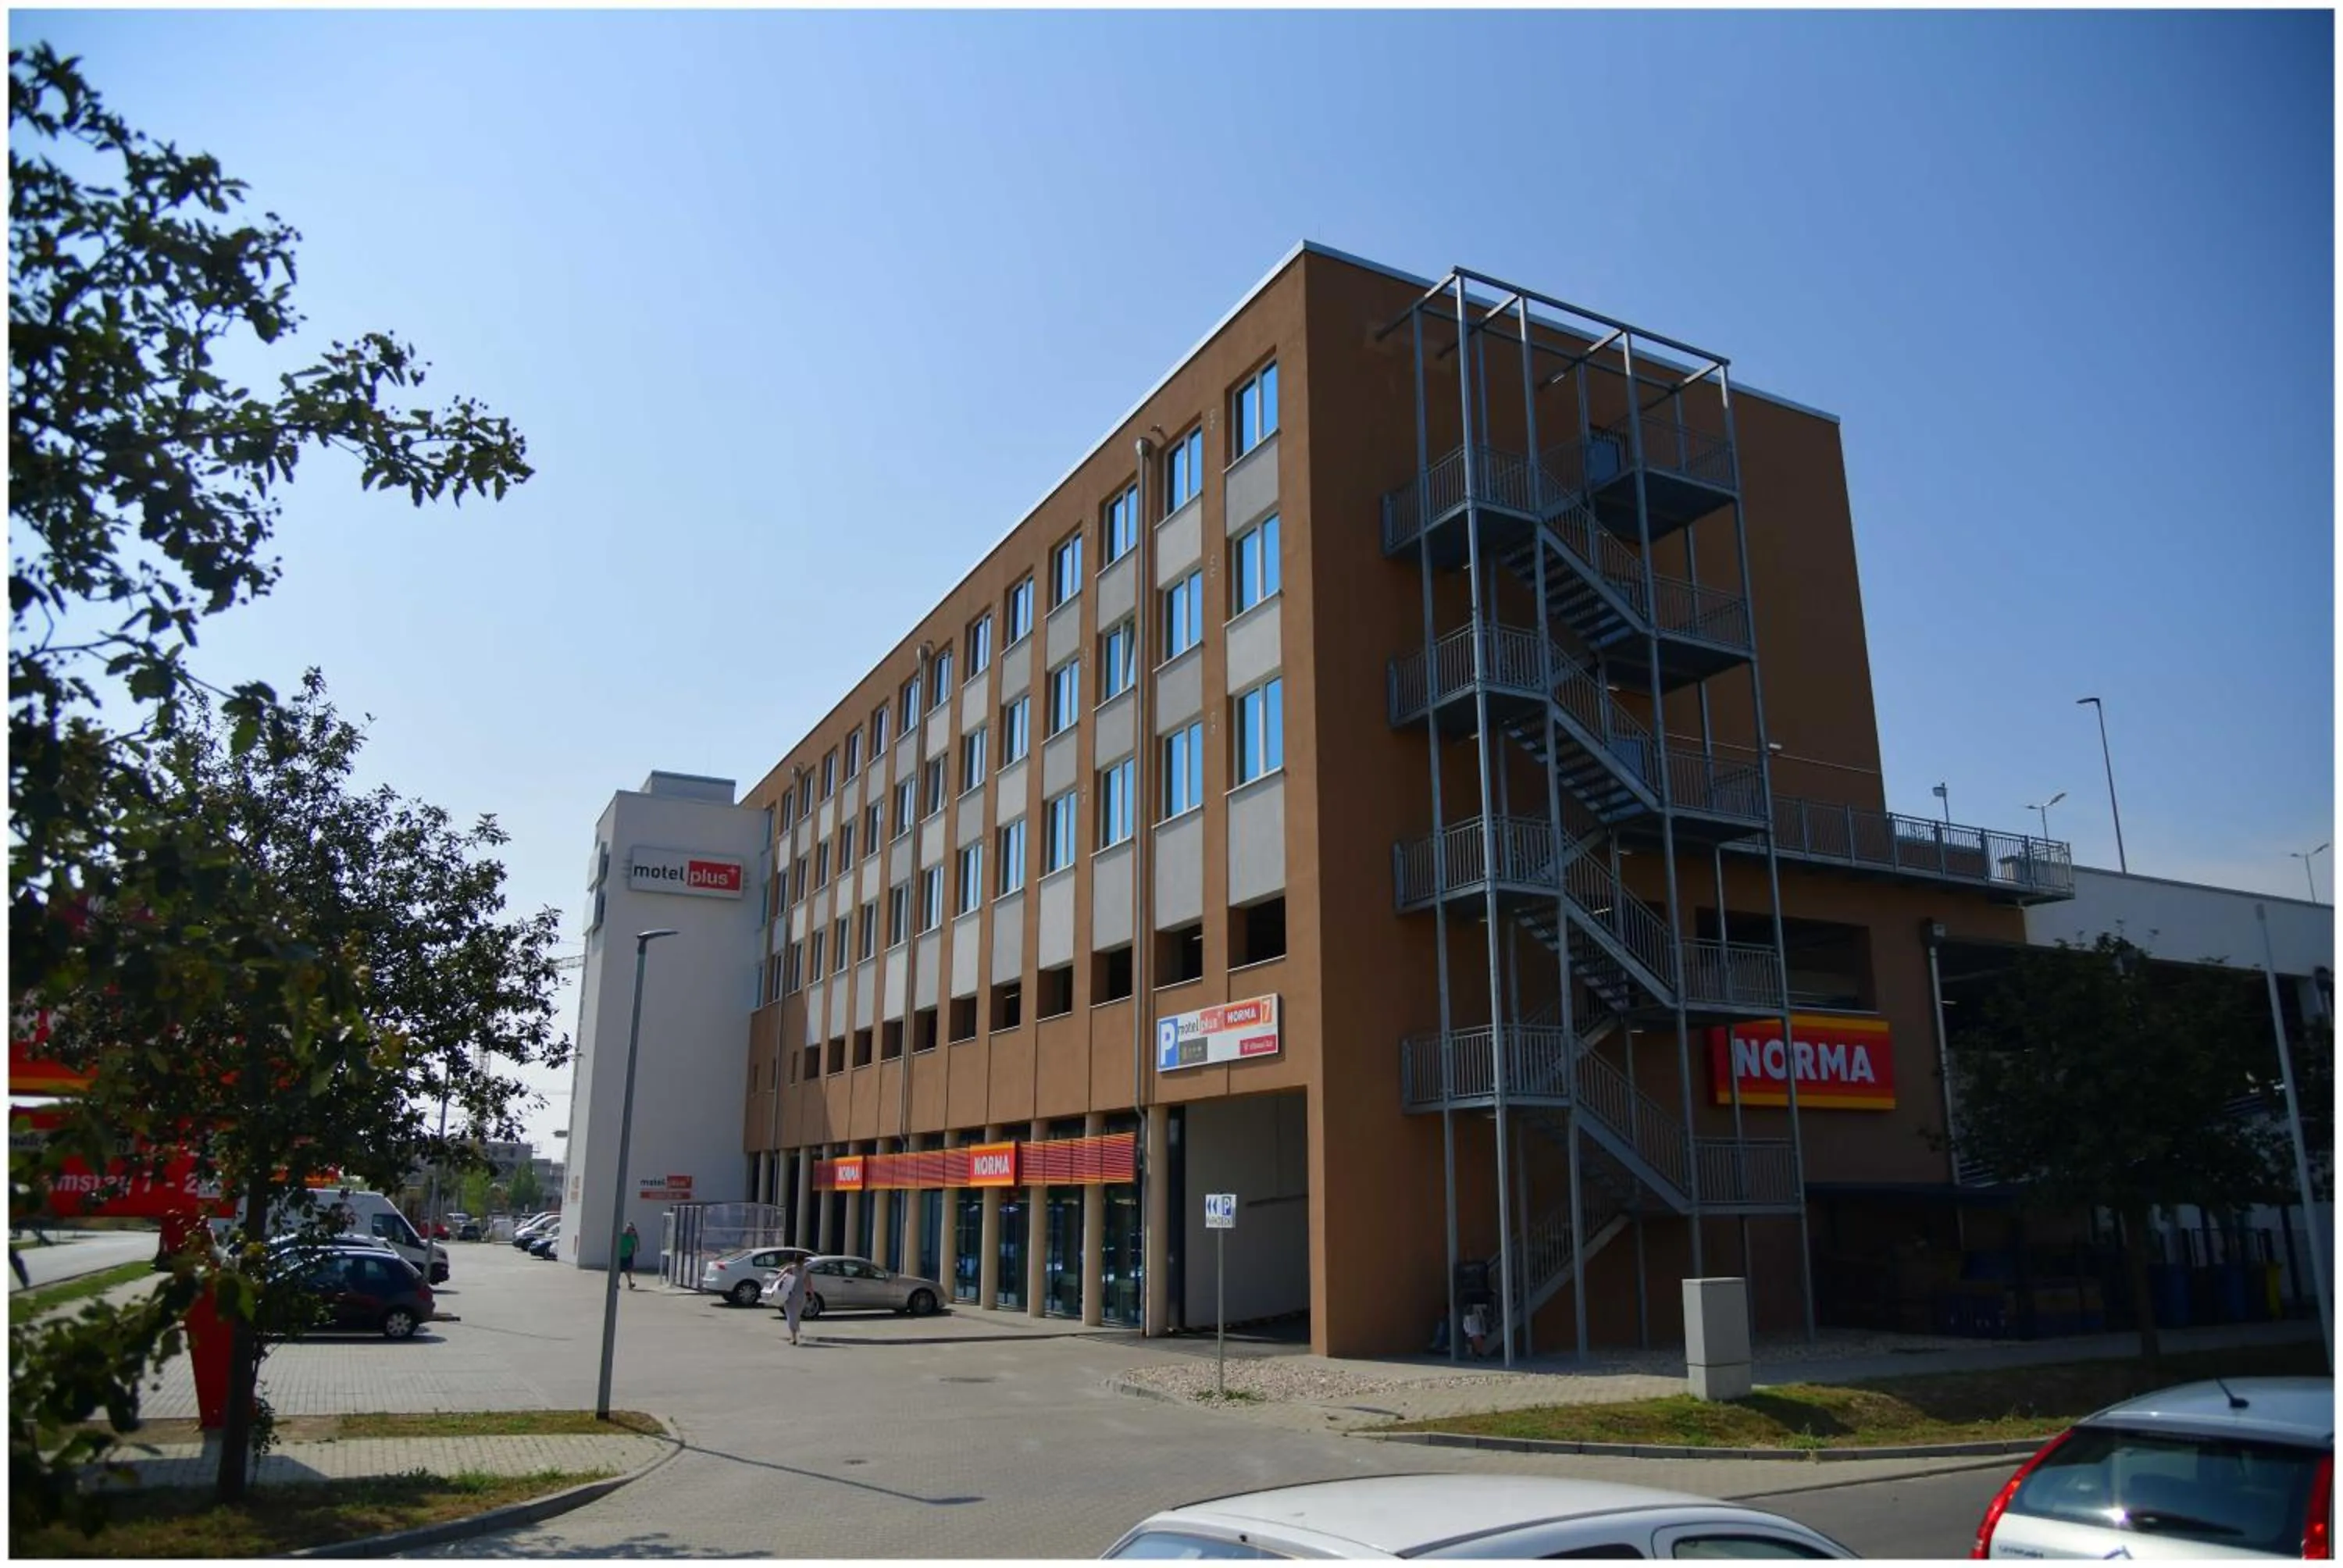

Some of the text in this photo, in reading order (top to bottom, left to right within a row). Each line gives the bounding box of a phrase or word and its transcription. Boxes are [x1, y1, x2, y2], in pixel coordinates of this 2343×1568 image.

[633, 864, 685, 882] motel
[1227, 1007, 1257, 1024] NORMA
[1161, 1022, 1175, 1065] P
[1734, 1038, 1875, 1083] NORMA
[838, 1164, 860, 1181] NORMA
[974, 1154, 1010, 1175] NORMA
